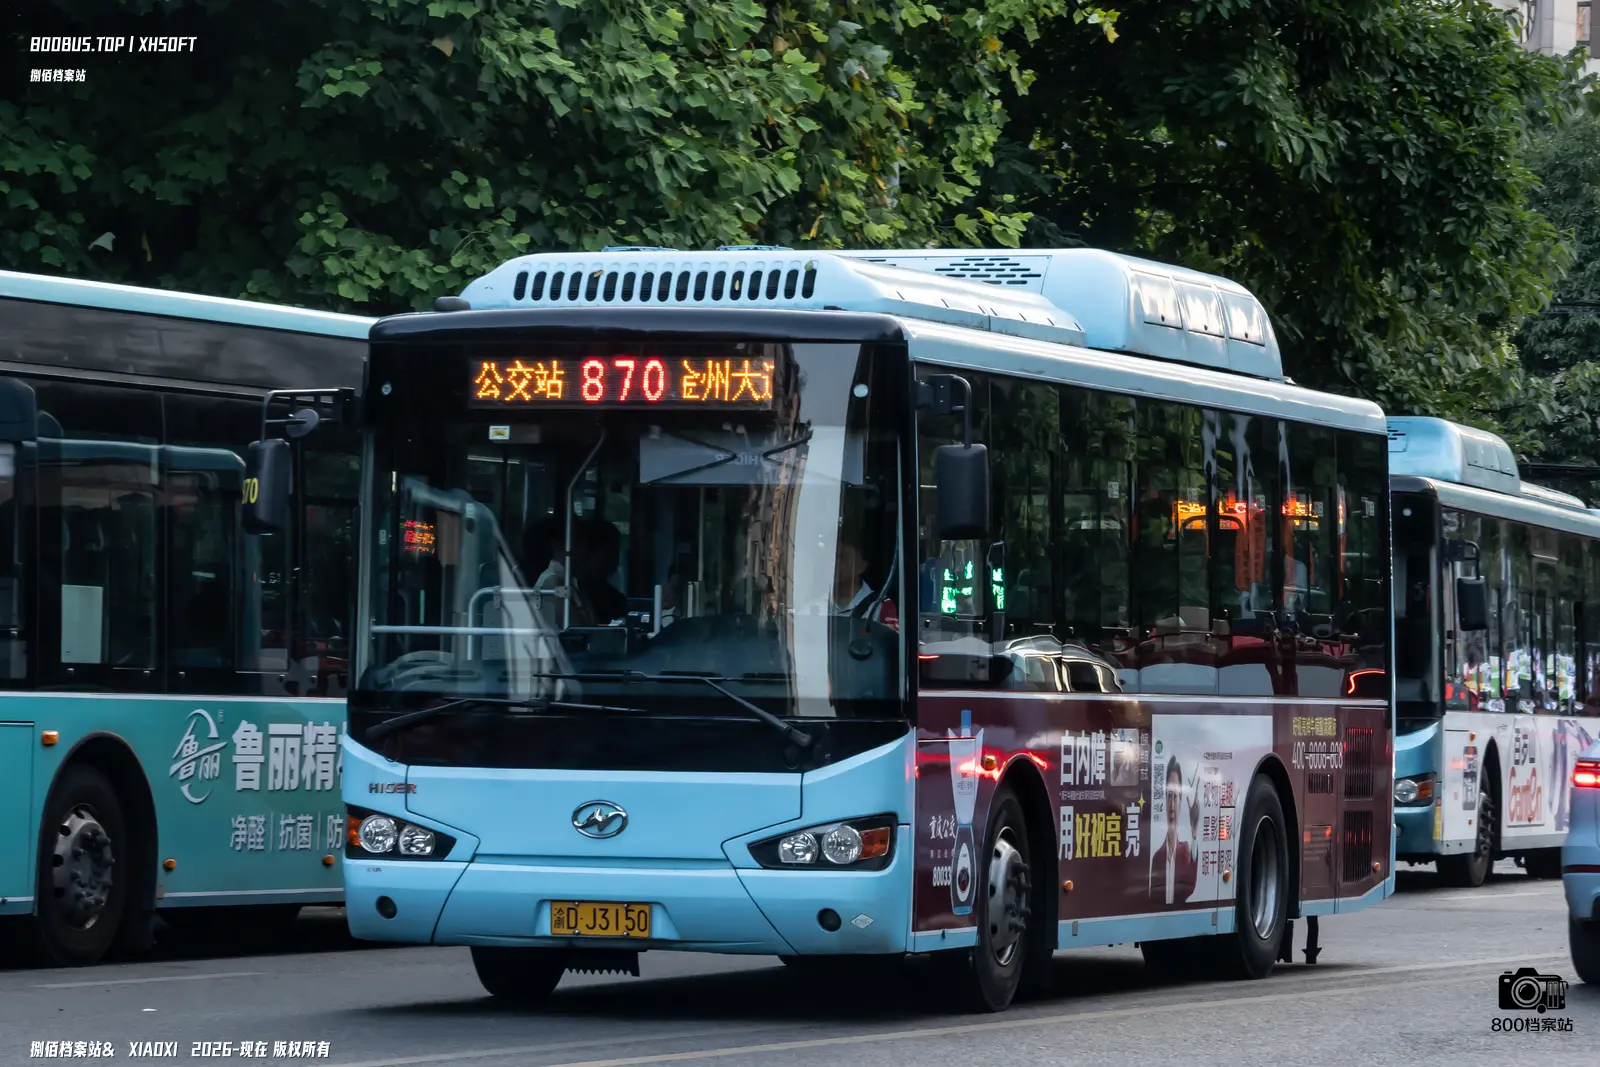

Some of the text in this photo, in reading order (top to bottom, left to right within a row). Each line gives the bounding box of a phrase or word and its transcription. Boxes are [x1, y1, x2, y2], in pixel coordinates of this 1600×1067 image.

[474, 361, 565, 401] 公交站
[581, 359, 666, 401] 870
[1060, 728, 1106, 786] 白内障
[368, 782, 418, 794] HIGER
[229, 814, 266, 851] 净醛
[278, 813, 313, 850] 抗菌
